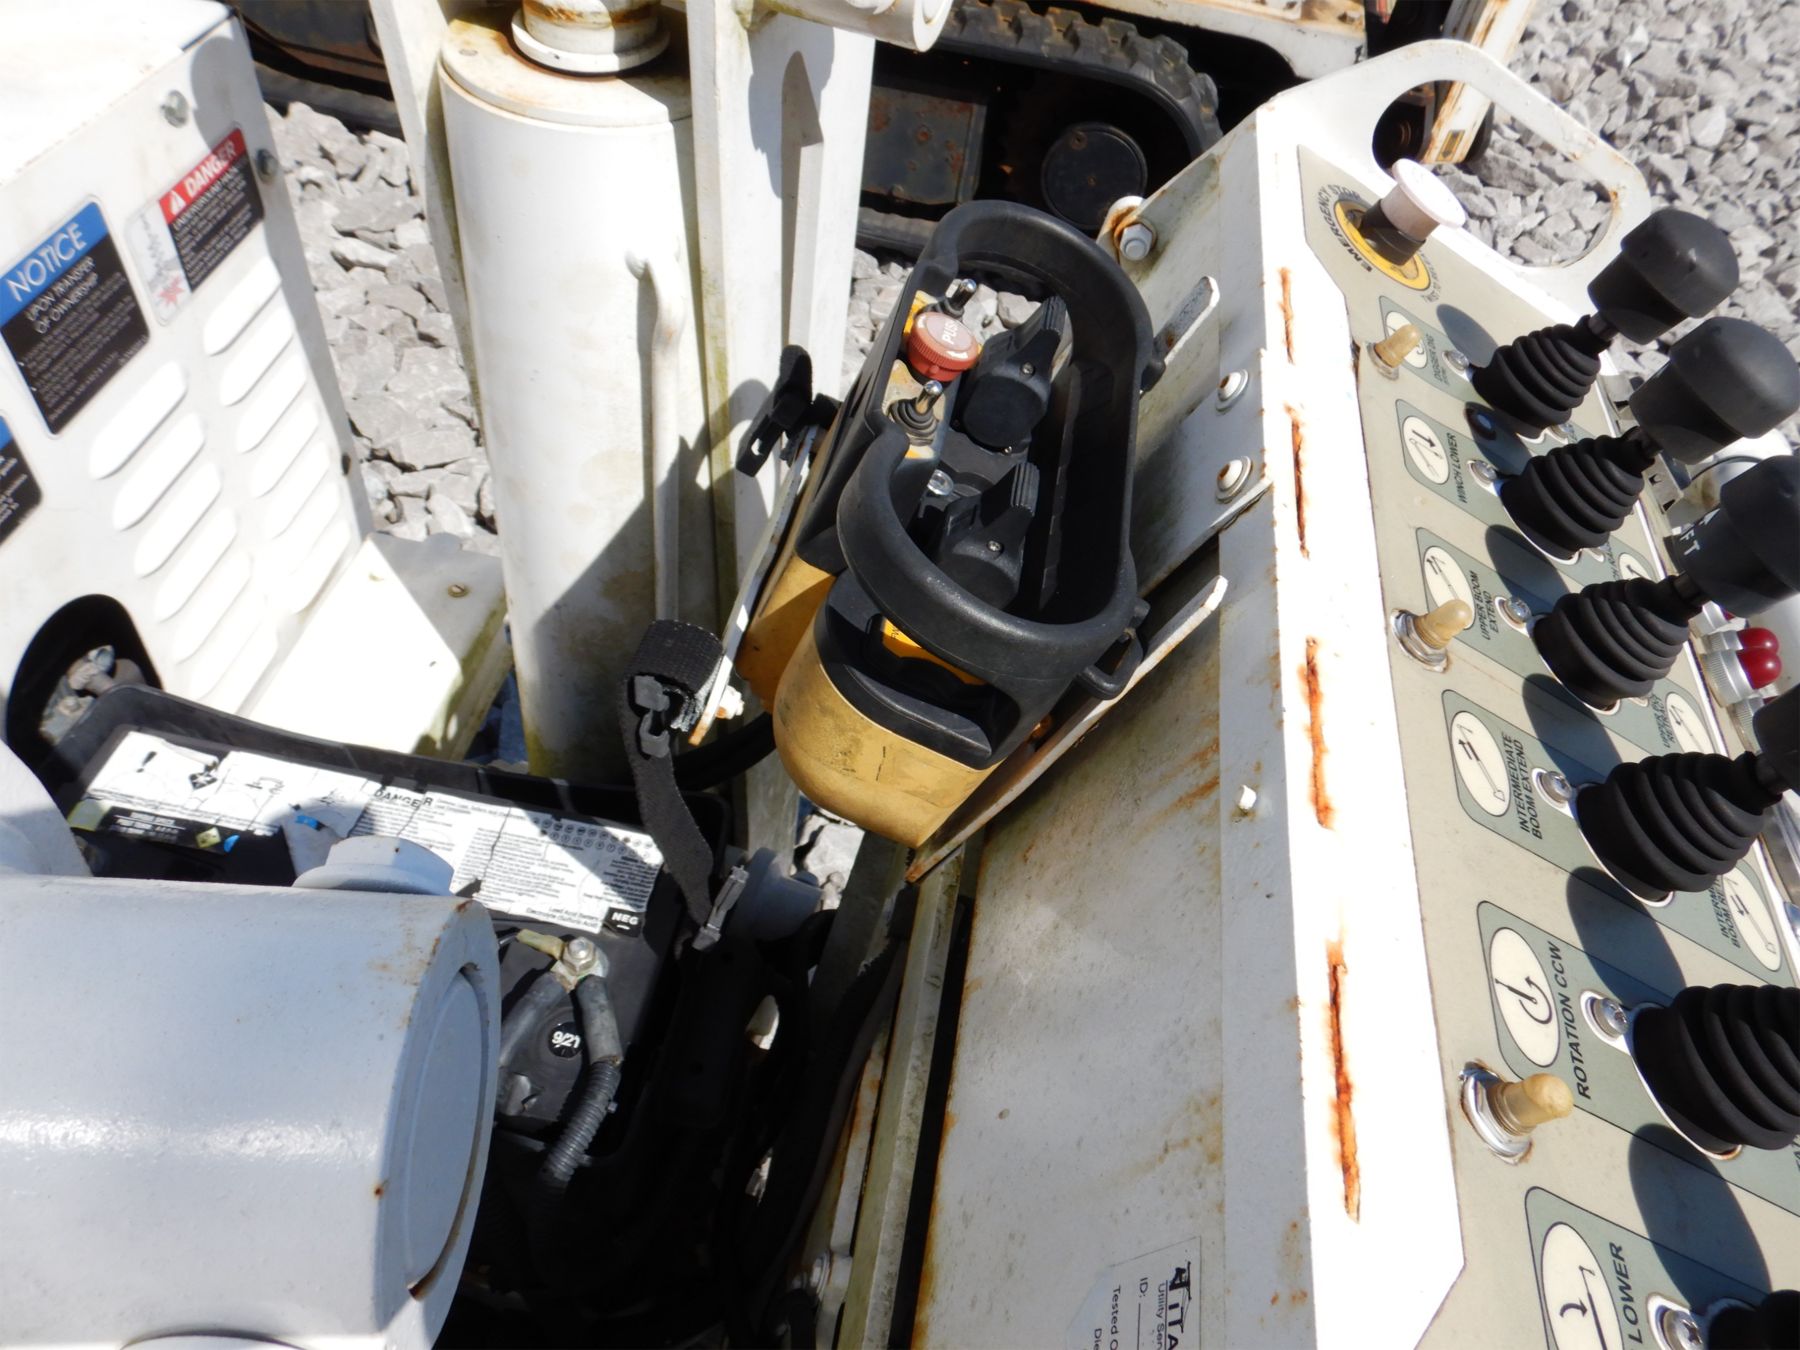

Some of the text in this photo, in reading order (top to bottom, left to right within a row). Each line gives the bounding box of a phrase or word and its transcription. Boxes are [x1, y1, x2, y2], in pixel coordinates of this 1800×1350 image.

[184, 140, 237, 199] DANGER
[6, 222, 87, 302] NOTICE
[1317, 186, 1372, 272] EMERGENCY
[24, 256, 95, 321] UPON TRANSFER
[33, 271, 98, 334] OF OWNERSHIP
[1446, 432, 1468, 504] WINCH LOWER
[1468, 570, 1491, 641] UPPER BOOM
[1482, 591, 1500, 634] EXTEND
[374, 790, 434, 808] DANGER
[1502, 732, 1531, 834] INTERMEDIATE
[1513, 739, 1543, 840] BOOM EXTEND
[611, 912, 639, 926] NEG
[551, 1031, 581, 1049] 9/21
[1547, 940, 1592, 1100] ROTATION CCW
[1111, 1284, 1121, 1335] Tested
[1139, 1277, 1148, 1298] ID:
[1155, 1283, 1165, 1350] Utility Ser
[1609, 1242, 1643, 1345] LOWER
